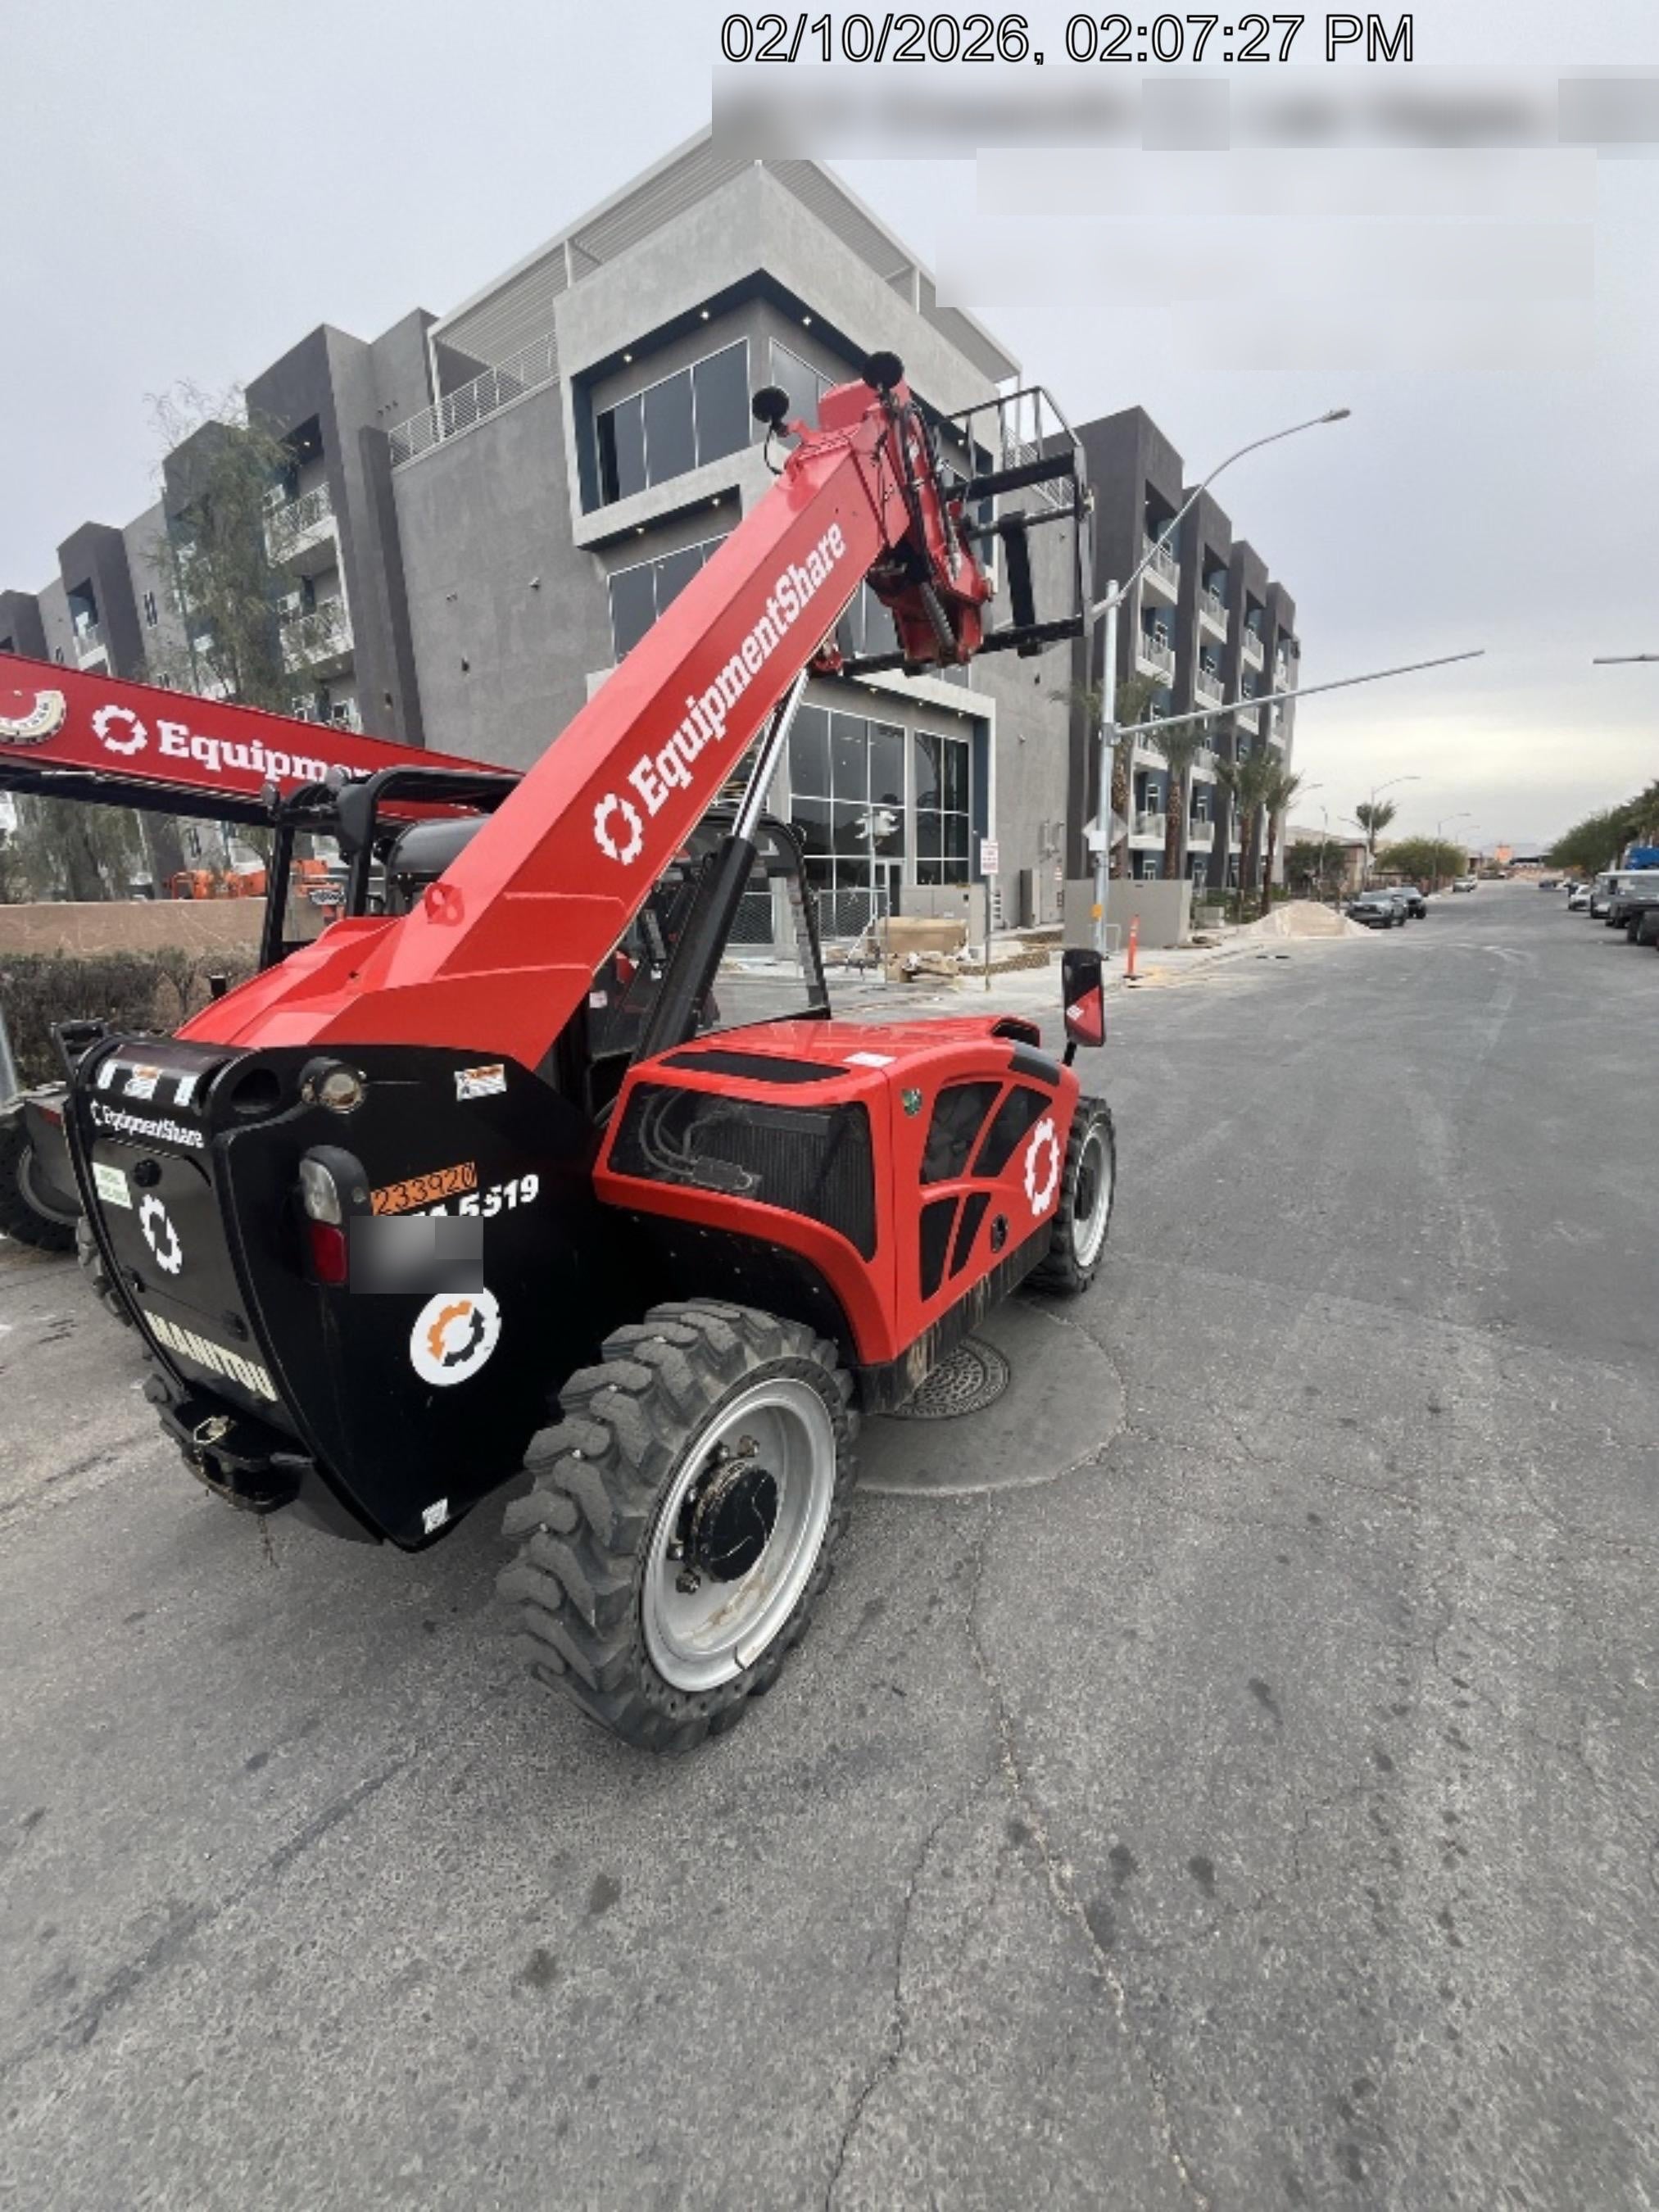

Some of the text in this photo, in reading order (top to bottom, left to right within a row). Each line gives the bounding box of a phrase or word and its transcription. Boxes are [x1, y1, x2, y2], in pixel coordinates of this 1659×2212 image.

[628, 522, 846, 817] EquipmentShare
[102, 1104, 205, 1149] EquipmentShare
[373, 1161, 477, 1215] 233920
